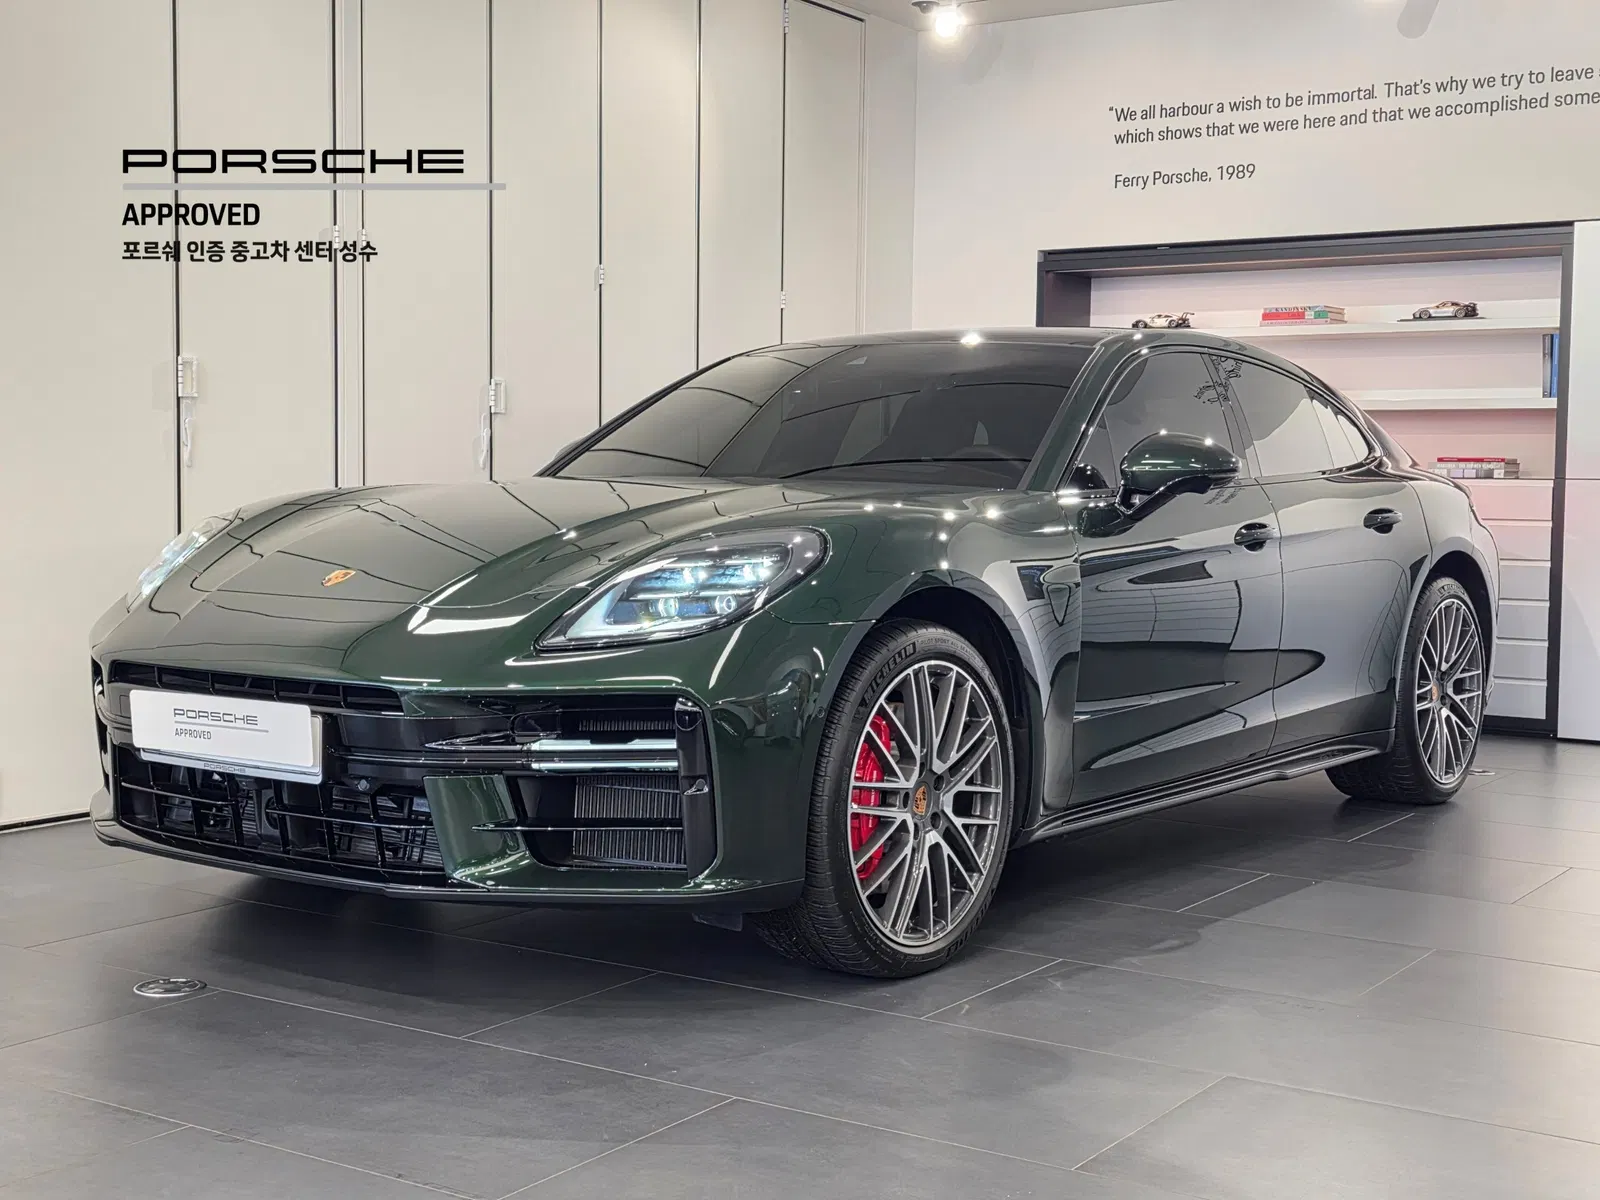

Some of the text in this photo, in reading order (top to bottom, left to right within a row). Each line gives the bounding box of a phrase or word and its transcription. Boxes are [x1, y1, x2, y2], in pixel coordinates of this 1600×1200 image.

[1140, 105, 1156, 120] all
[1160, 102, 1214, 119] harbour
[1216, 102, 1225, 113] a
[1229, 95, 1262, 112] wish
[1266, 95, 1281, 109] to
[1285, 92, 1303, 108] be
[1307, 84, 1378, 106] immortal.
[1435, 76, 1468, 94] why
[1472, 76, 1496, 89] we
[1500, 72, 1524, 90] try
[1528, 70, 1545, 85] to
[1550, 66, 1594, 82] leave
[1114, 91, 1600, 144] which shows that we were here and that we accomplished some
[1114, 163, 1256, 190] Ferry Porsche, 1989
[864, 642, 916, 704] MICHELIN
[173, 708, 258, 726] PORSCHE
[174, 728, 212, 740] APPROVED
[203, 763, 246, 774] PORSCHE
